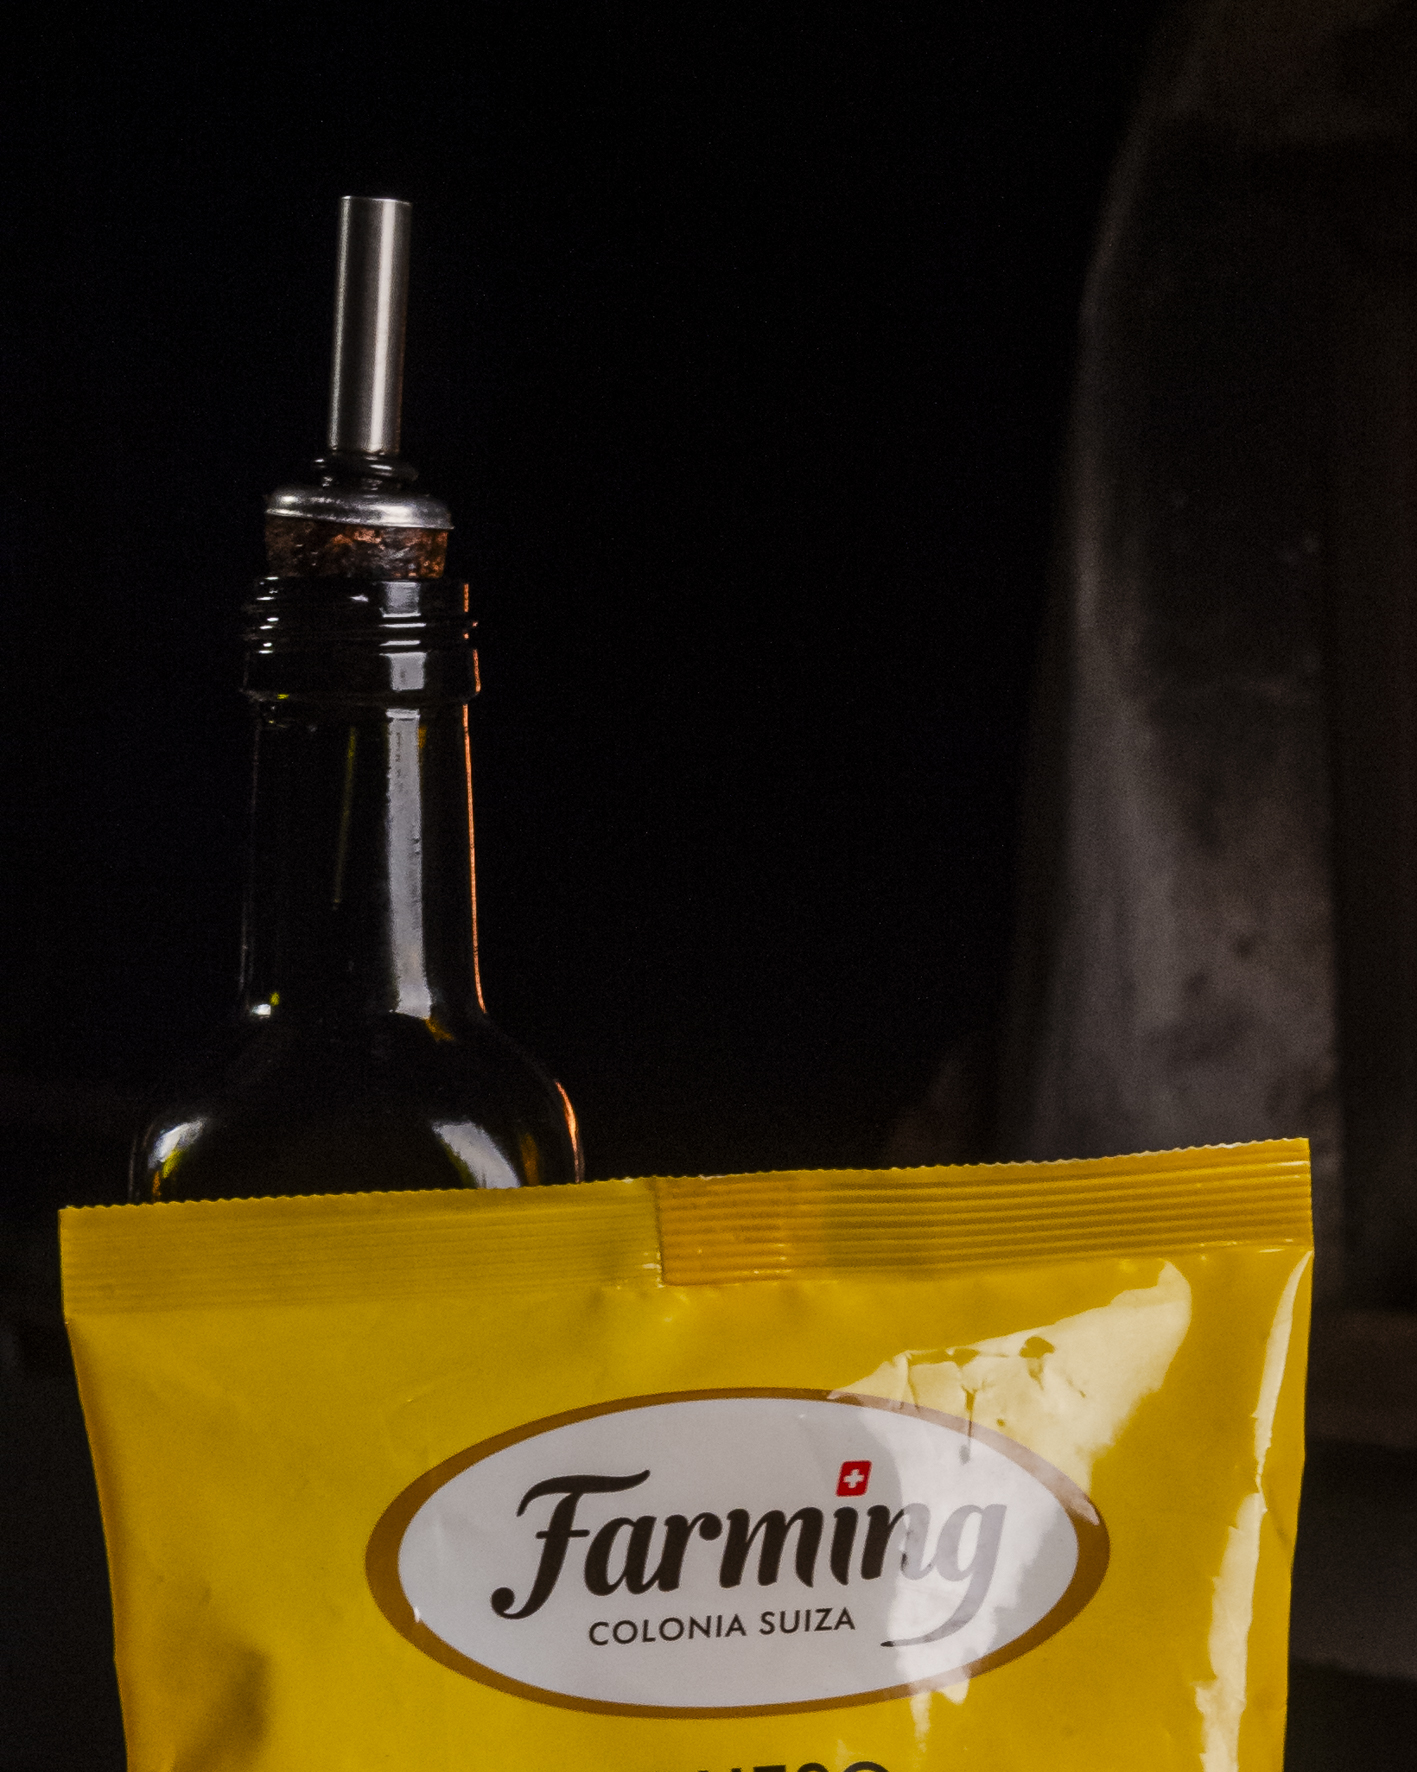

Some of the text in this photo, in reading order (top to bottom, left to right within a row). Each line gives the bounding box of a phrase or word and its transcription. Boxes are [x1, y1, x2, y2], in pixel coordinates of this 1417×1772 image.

[490, 1460, 1008, 1648] Farming
[588, 1606, 856, 1647] COLONIA SUIZA
